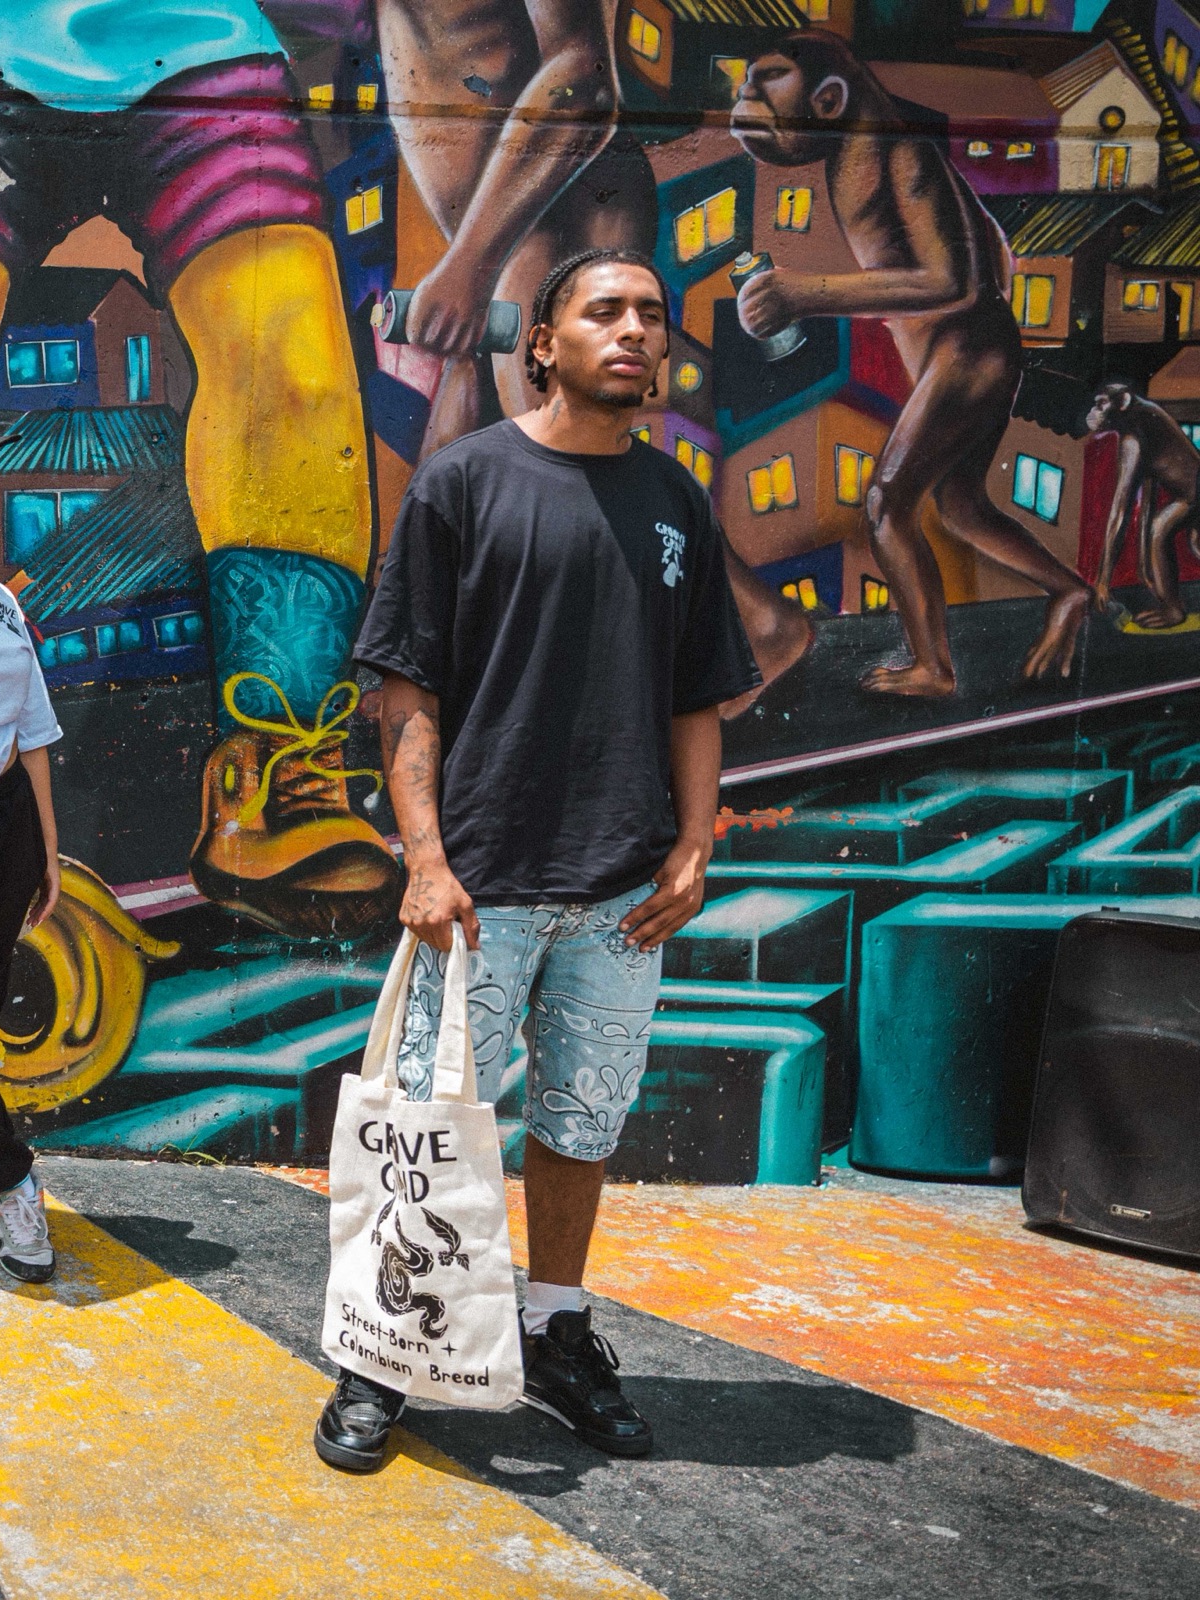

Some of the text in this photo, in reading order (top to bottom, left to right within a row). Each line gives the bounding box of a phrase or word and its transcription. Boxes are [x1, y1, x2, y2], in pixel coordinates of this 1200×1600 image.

[358, 1120, 457, 1166] GRVE
[341, 1303, 430, 1354] Street-Born
[339, 1330, 490, 1387] Colombian Bread
